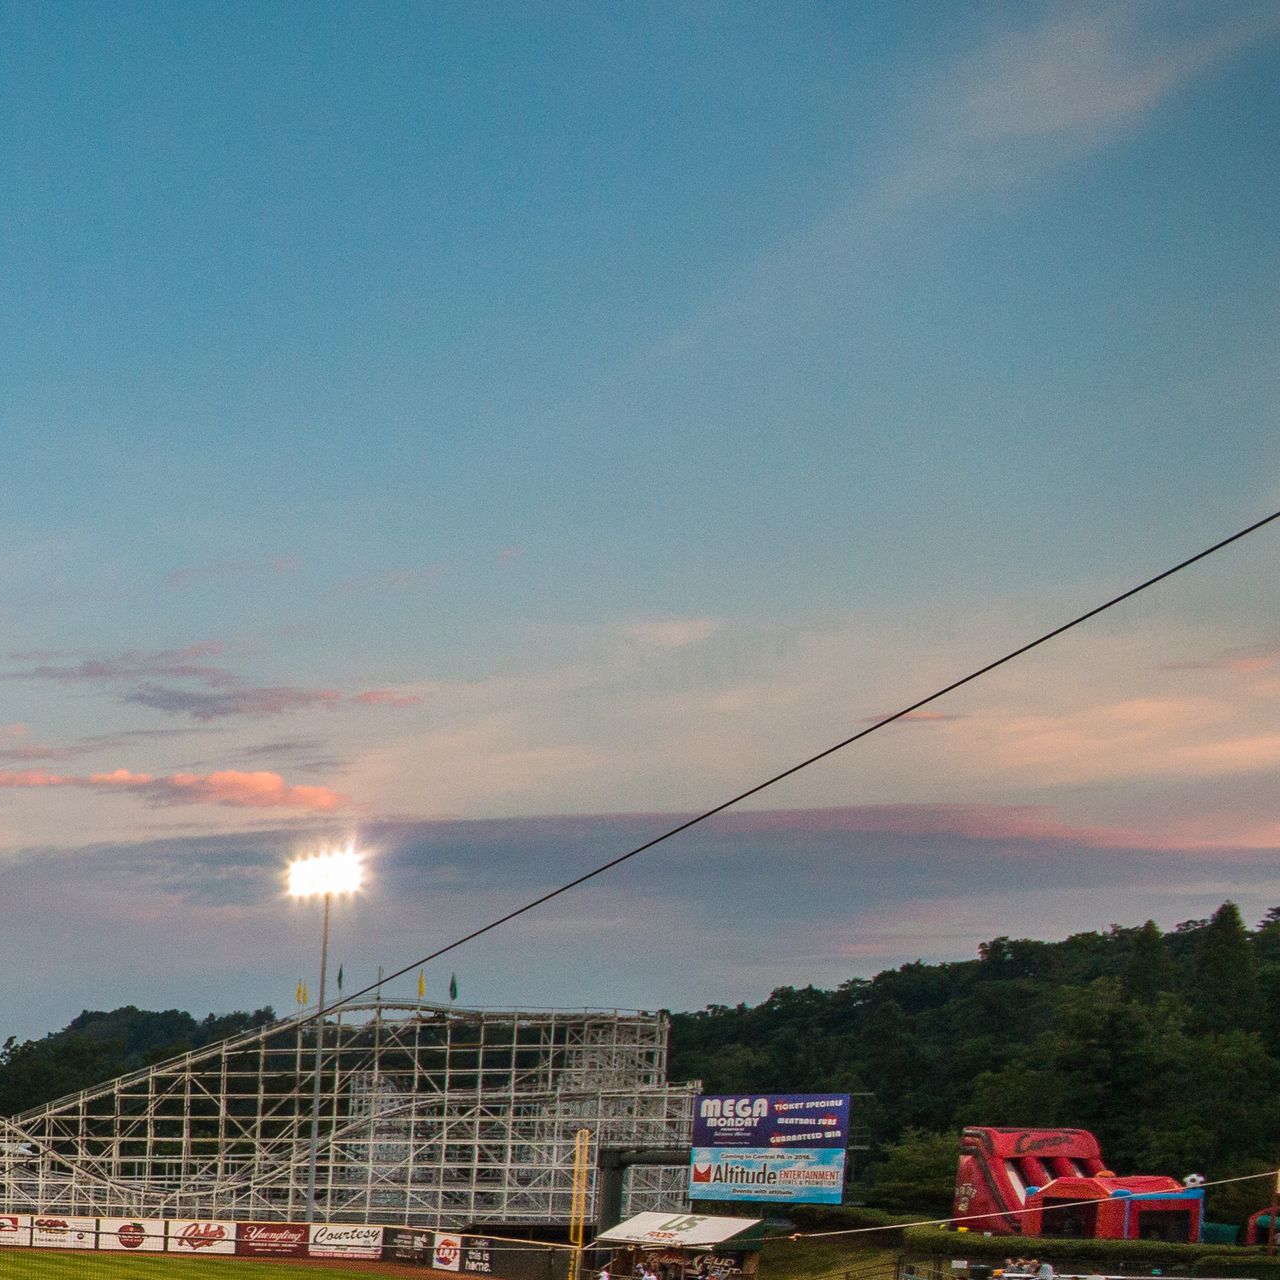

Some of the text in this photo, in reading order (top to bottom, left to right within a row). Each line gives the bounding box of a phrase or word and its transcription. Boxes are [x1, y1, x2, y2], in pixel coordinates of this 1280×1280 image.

[700, 1098, 769, 1118] MEGA
[774, 1100, 843, 1111] TICKET SPECIALS
[706, 1117, 760, 1127] MONDAY
[712, 1162, 777, 1185] Altitude
[779, 1170, 840, 1180] ENTERTAINMENT
[244, 1225, 305, 1243] Yuengling
[314, 1226, 381, 1244] Courtesy
[468, 1250, 490, 1260] this is
[465, 1260, 492, 1273] home.
